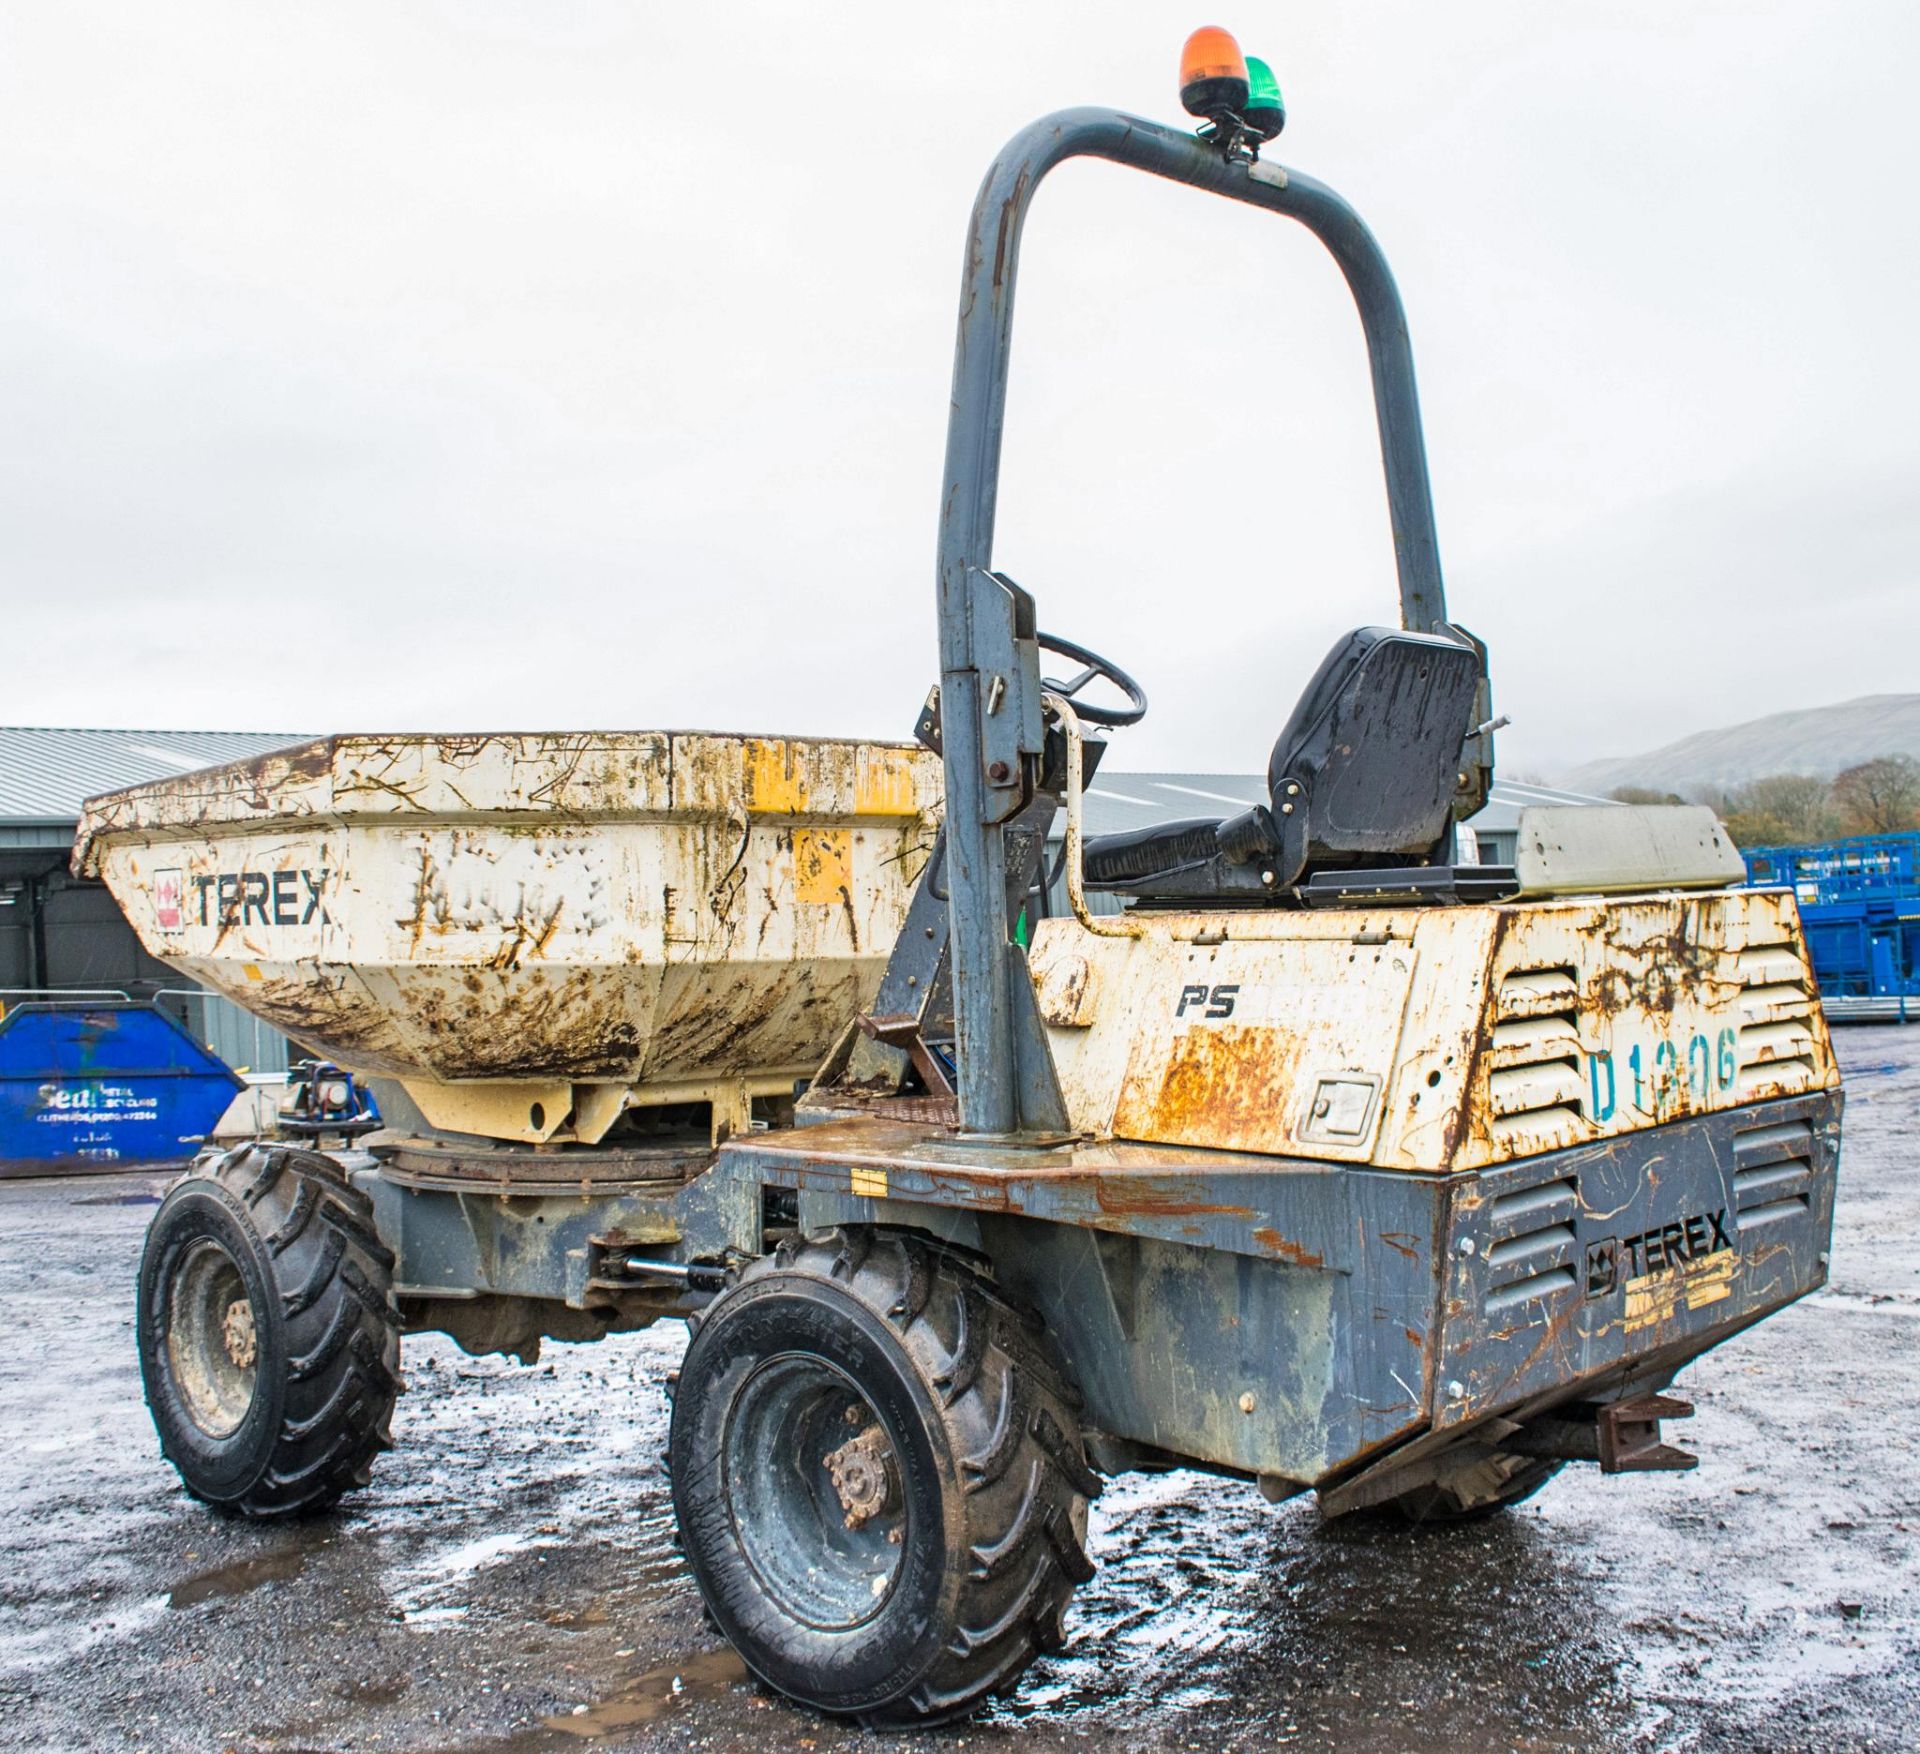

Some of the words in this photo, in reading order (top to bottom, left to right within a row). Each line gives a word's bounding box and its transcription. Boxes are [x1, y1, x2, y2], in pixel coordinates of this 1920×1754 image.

[191, 868, 332, 926] TEREX
[1175, 984, 1240, 1018] PS
[1624, 1208, 1733, 1278] TEREX
